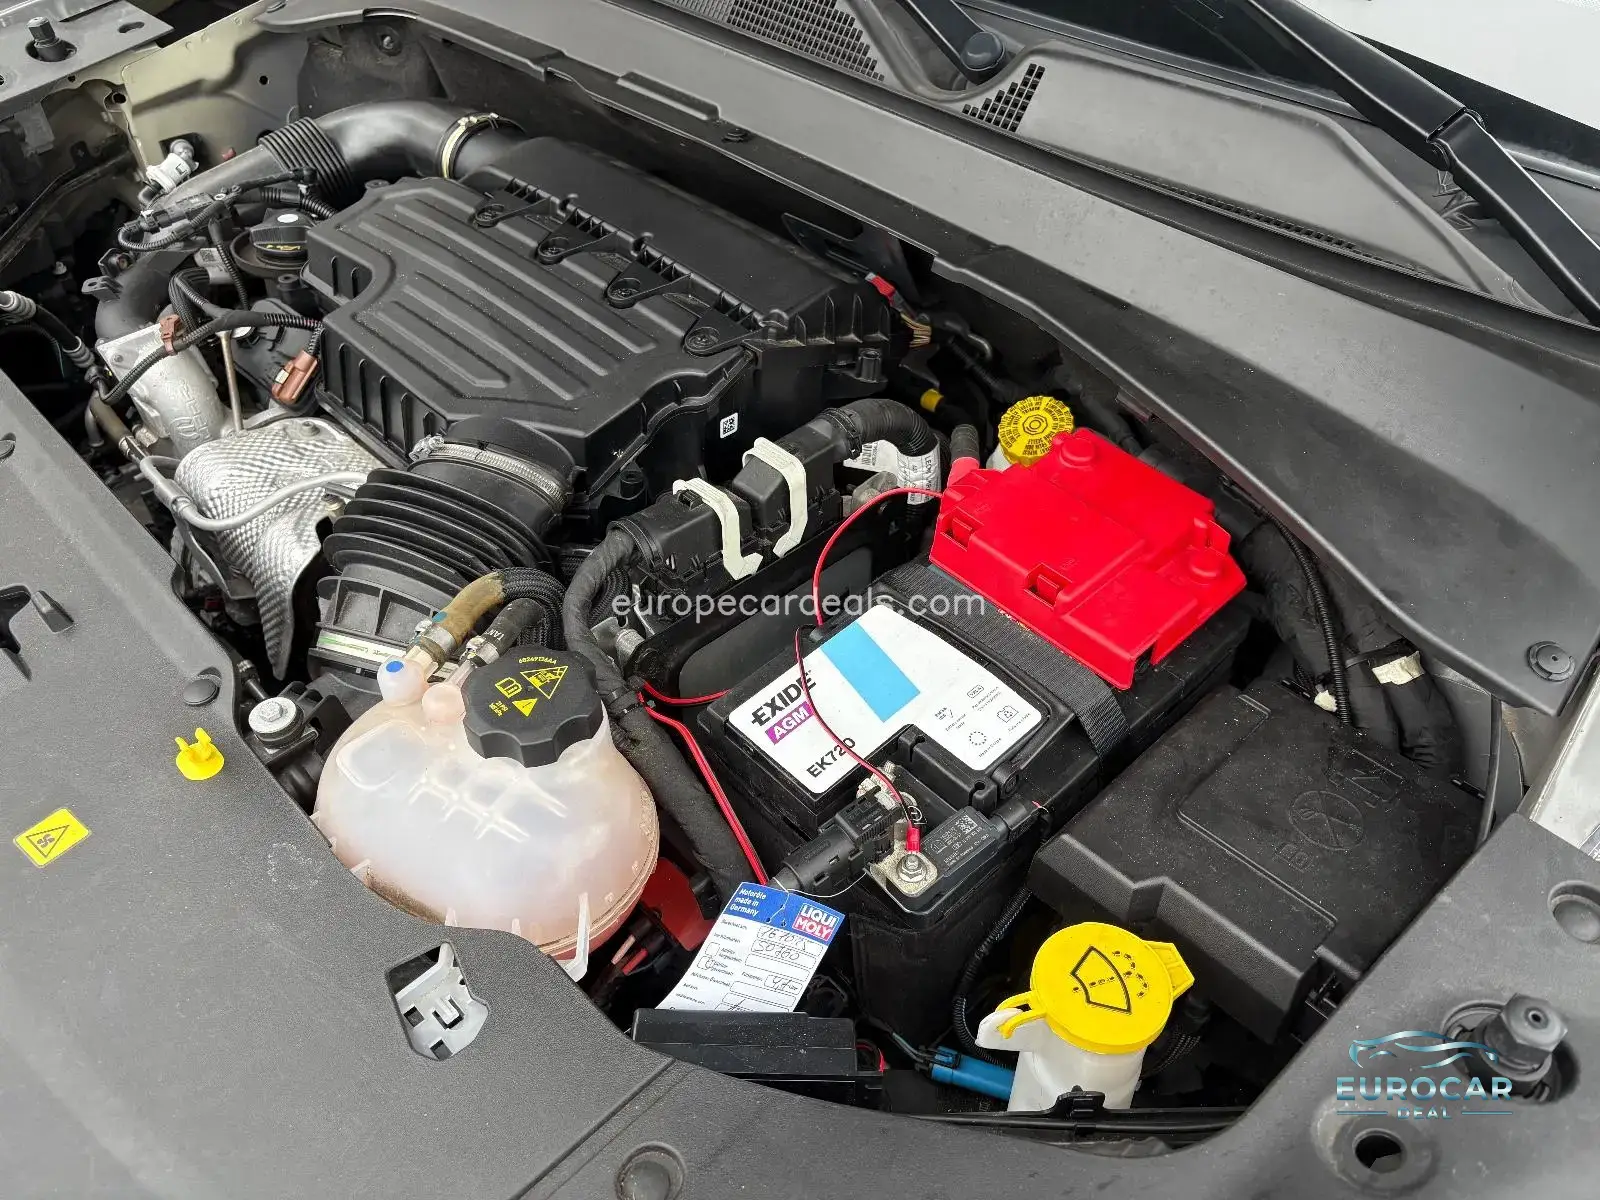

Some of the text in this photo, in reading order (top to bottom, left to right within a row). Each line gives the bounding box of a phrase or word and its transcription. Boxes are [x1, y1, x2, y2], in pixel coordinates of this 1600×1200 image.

[751, 671, 817, 727] EXIDE
[773, 705, 810, 740] AGM
[806, 737, 856, 779] EK720
[734, 896, 752, 905] made
[739, 888, 767, 900] Motoröle
[729, 903, 760, 917] Germany
[802, 904, 838, 927] LIQUI
[795, 916, 832, 939] MOLY
